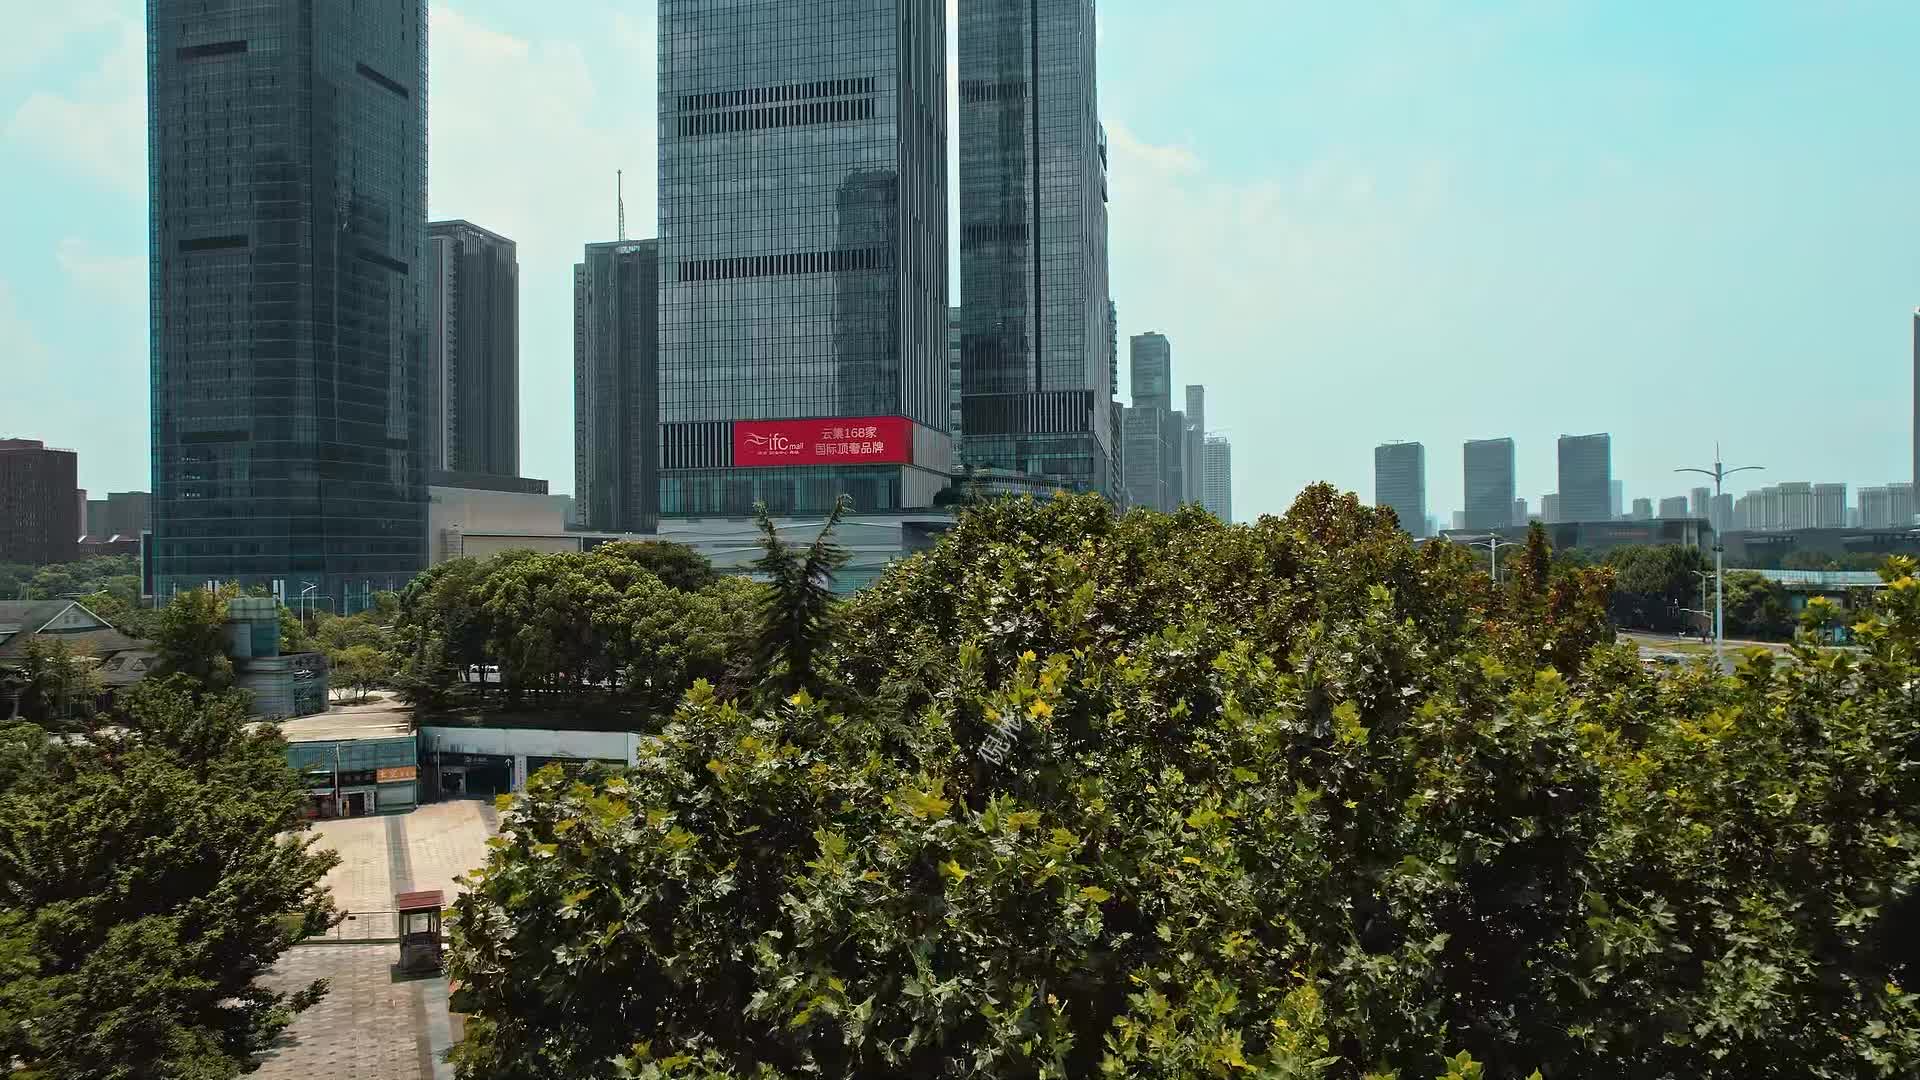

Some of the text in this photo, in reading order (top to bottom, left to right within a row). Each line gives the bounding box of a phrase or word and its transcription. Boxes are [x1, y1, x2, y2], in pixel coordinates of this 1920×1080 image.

[769, 433, 804, 450] ifc mall
[815, 441, 884, 456] 国际顶奢品牌
